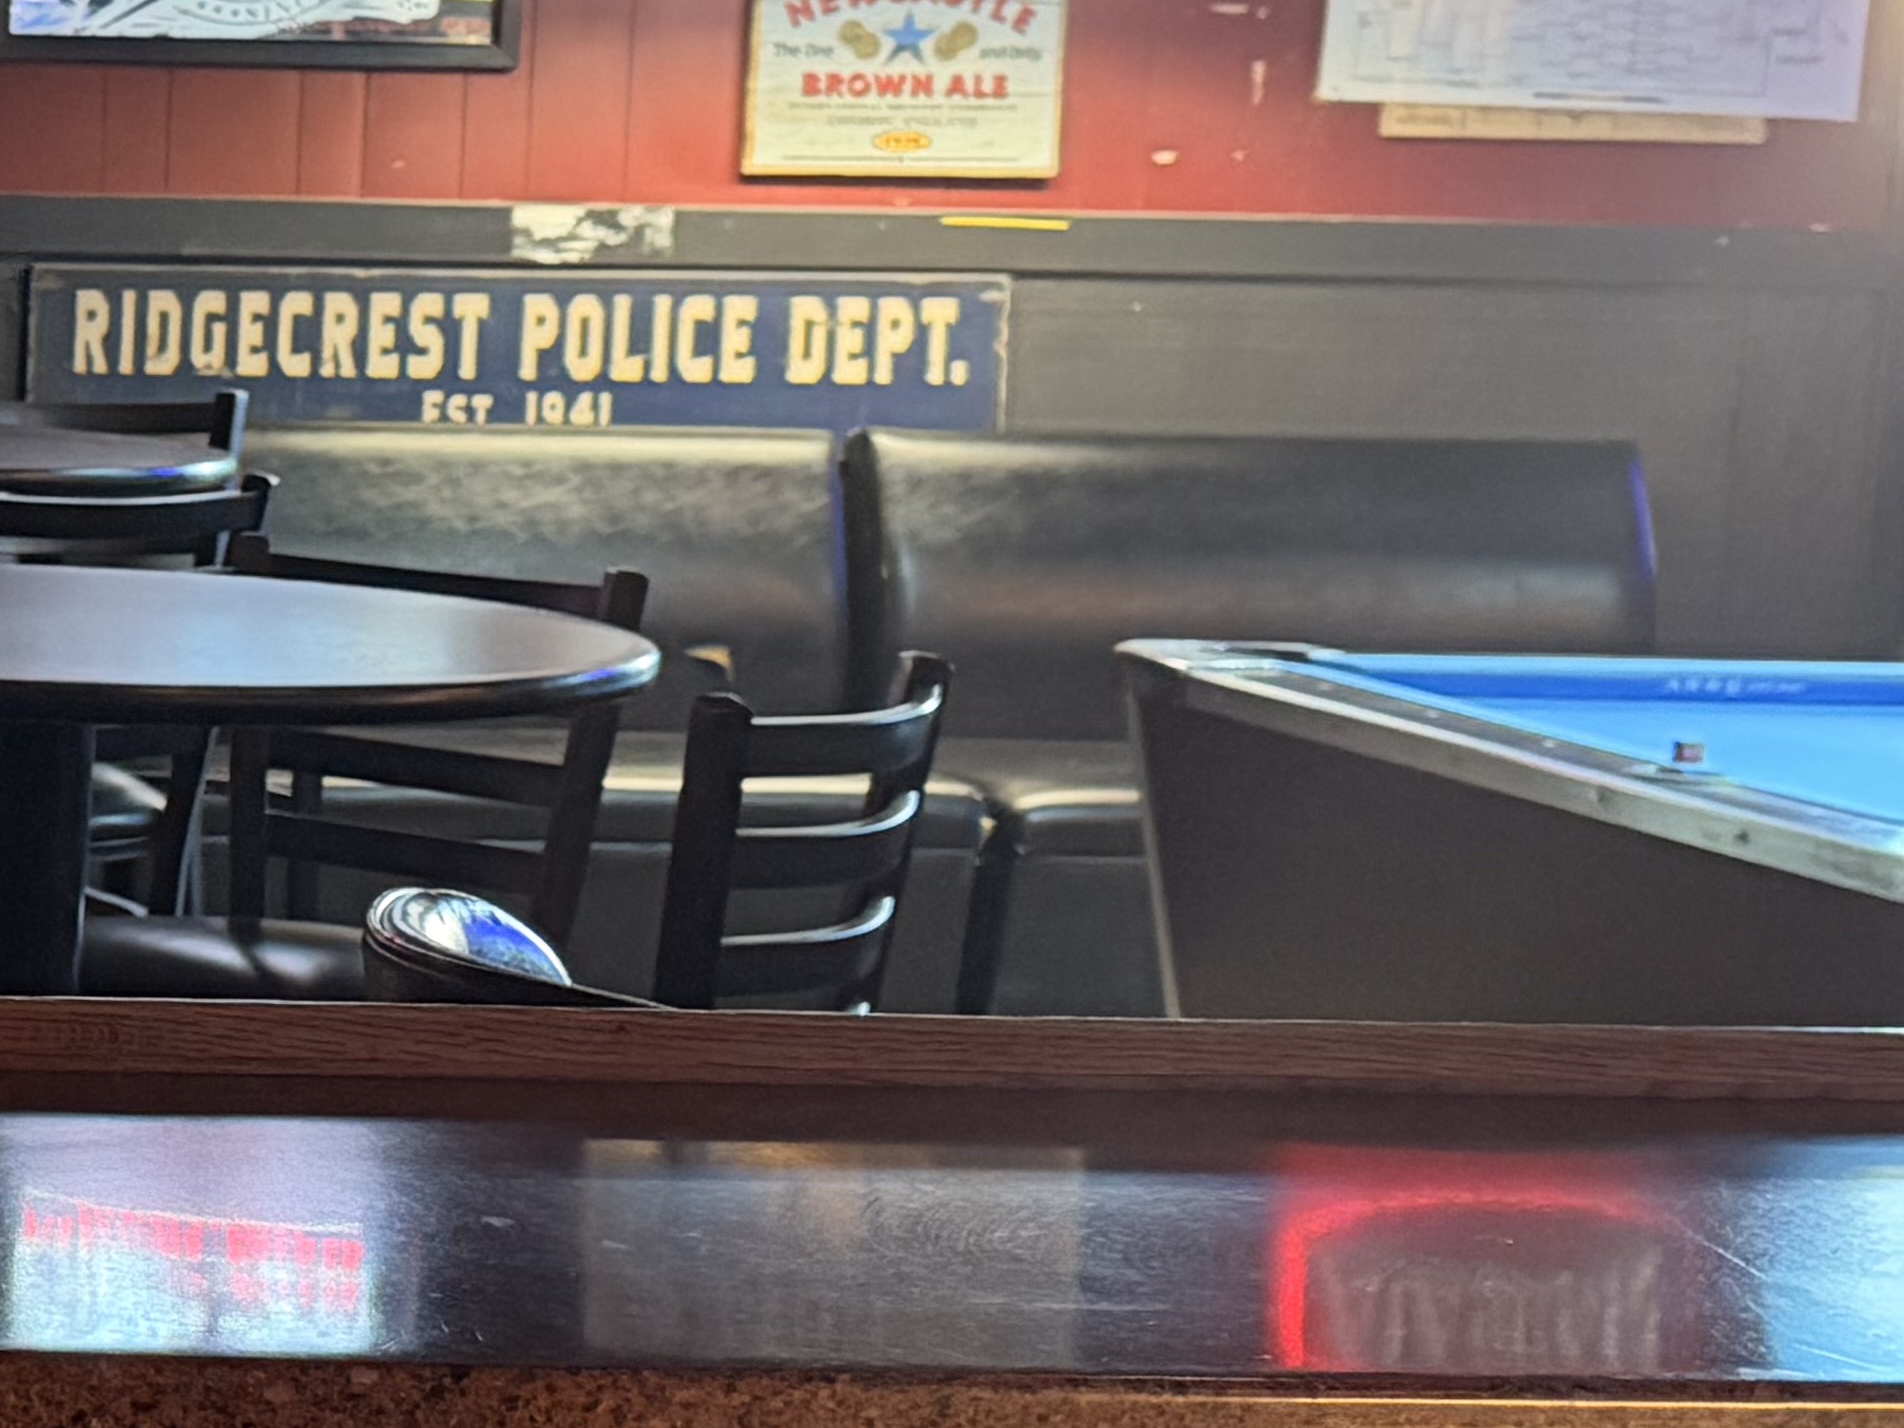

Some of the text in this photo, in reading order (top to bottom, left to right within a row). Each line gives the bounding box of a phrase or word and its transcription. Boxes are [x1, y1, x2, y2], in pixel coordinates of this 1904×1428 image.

[801, 73, 1010, 99] BROWN ALE
[73, 287, 968, 386] RIDGECREST POLICE DEPT.
